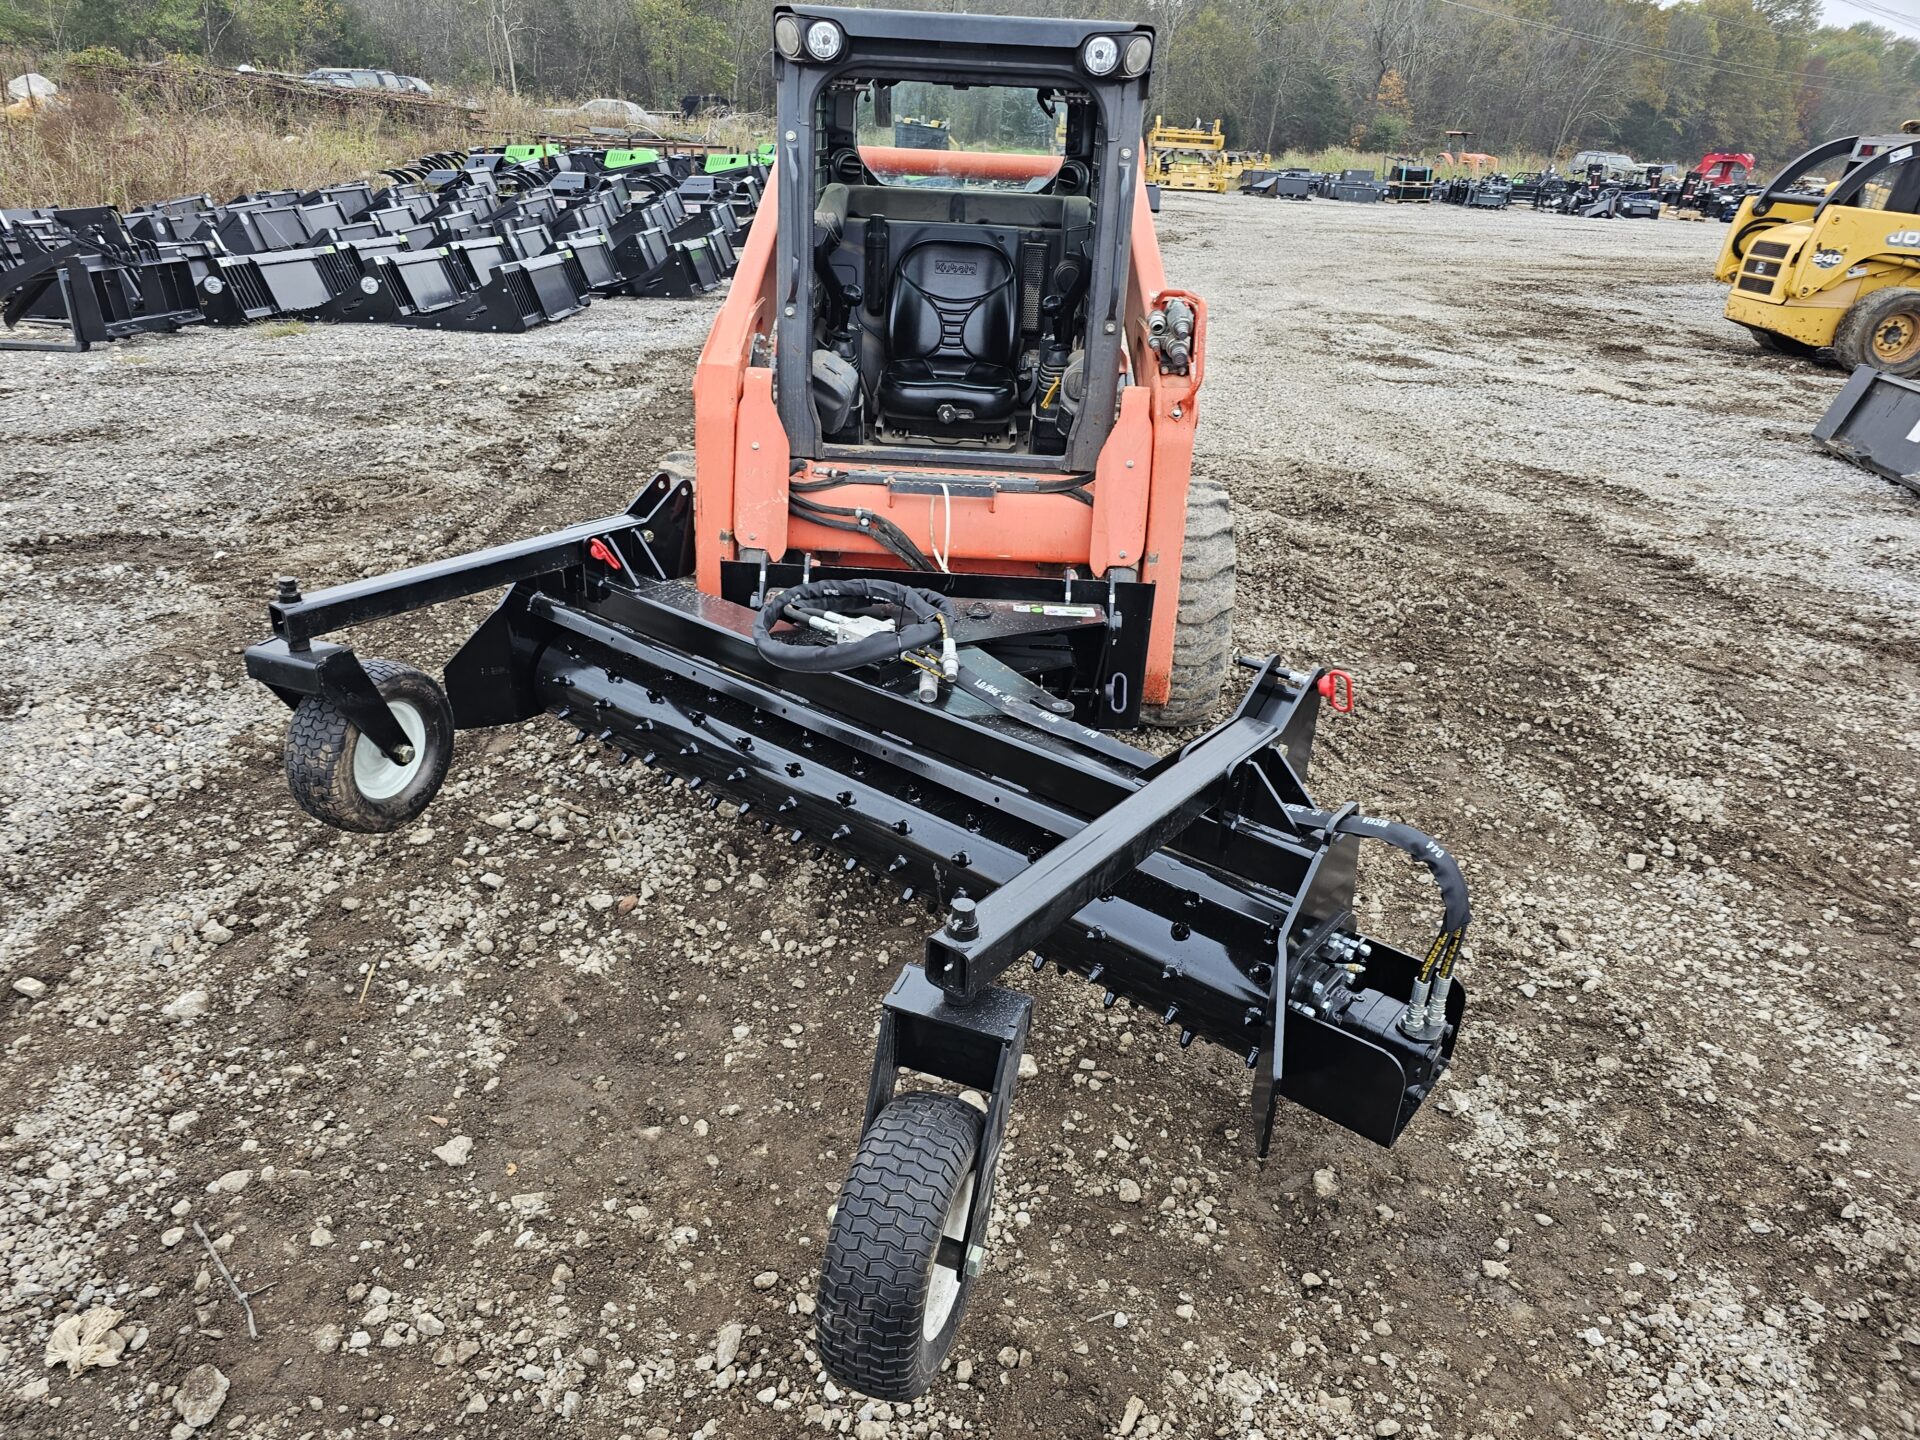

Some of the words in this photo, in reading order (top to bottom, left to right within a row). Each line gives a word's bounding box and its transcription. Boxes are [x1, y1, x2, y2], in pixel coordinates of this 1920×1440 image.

[1812, 253, 1843, 264] 240
[1362, 817, 1391, 828] MSHA
[1426, 841, 1445, 858] 044
